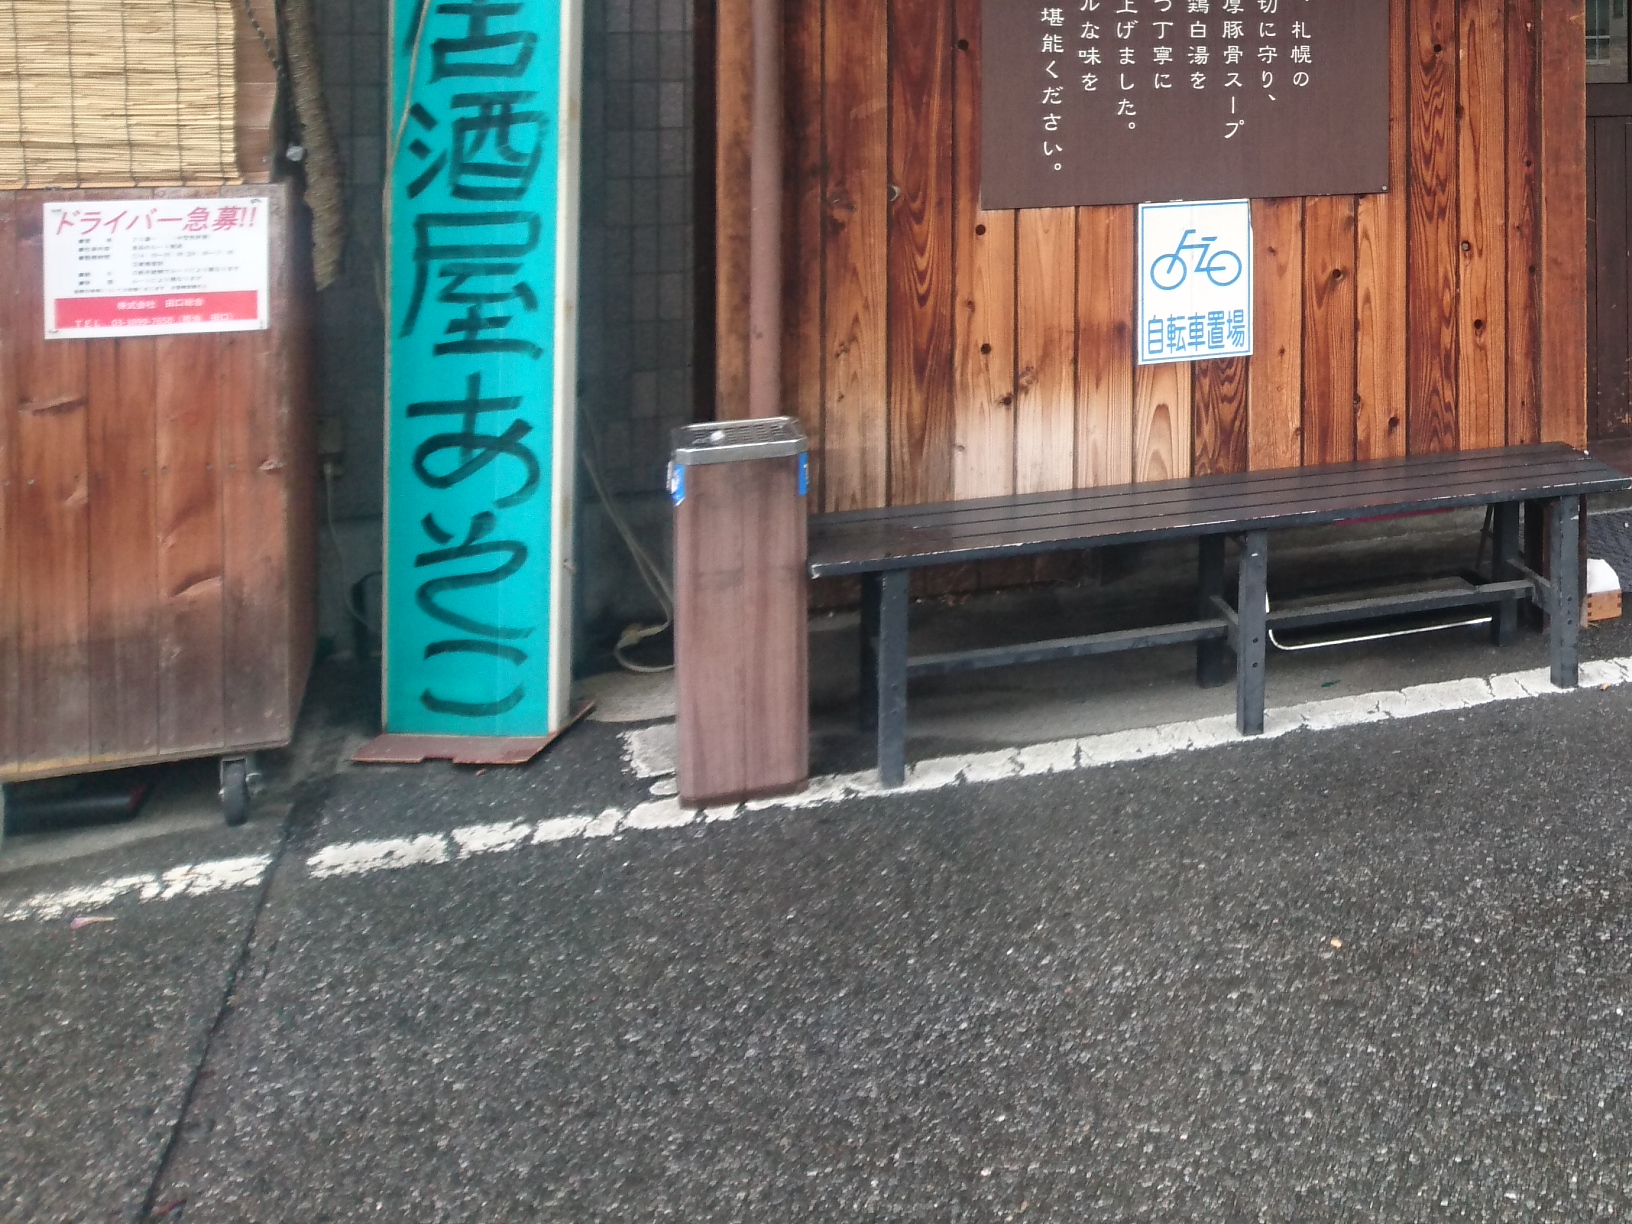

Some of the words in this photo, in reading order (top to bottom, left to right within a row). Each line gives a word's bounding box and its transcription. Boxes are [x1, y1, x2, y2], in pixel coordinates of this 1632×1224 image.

[1147, 309, 1246, 355] 自転車置場
